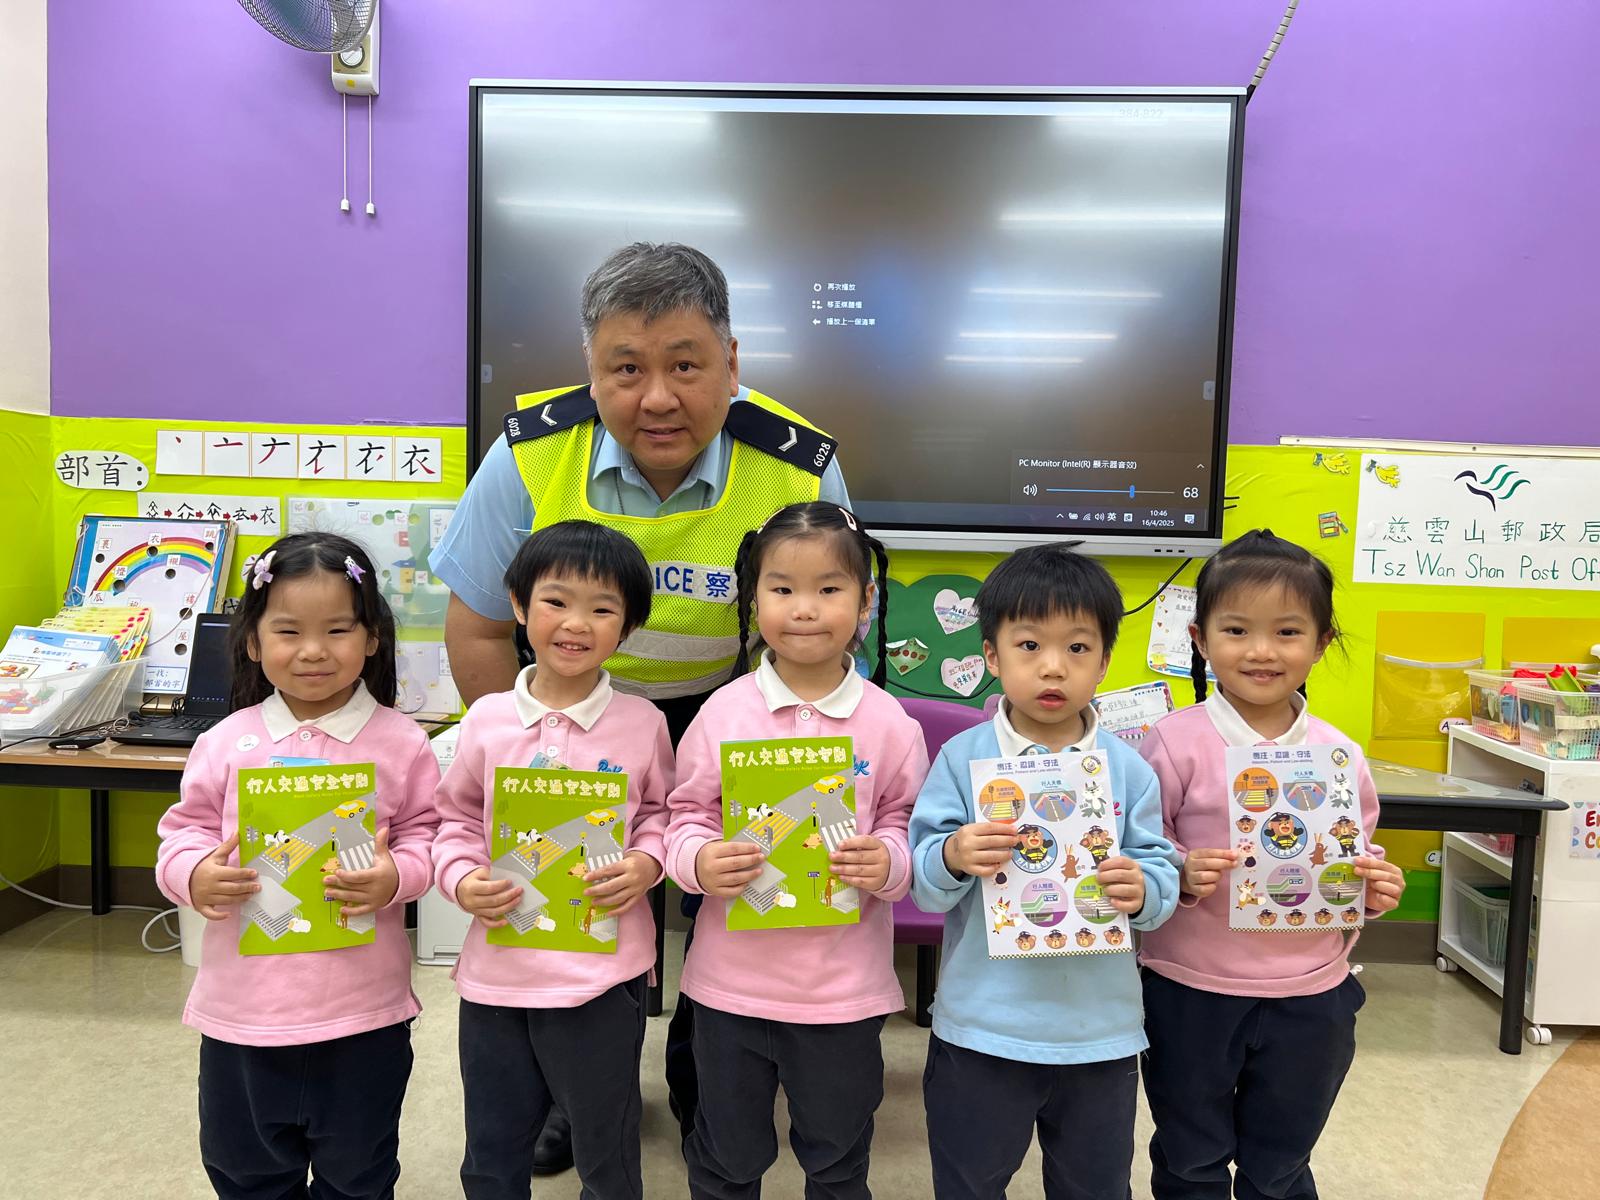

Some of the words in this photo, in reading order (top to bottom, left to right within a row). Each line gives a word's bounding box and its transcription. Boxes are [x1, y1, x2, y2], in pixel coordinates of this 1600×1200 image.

[507, 417, 521, 437] 6028
[813, 442, 831, 467] 6028
[1018, 459, 1029, 467] PC
[1030, 459, 1060, 468] Monitor
[1062, 459, 1091, 469] (Intel(R)
[1183, 487, 1199, 498] 68
[1107, 512, 1117, 522] 英
[1141, 518, 1175, 527] 16/4/2025
[1383, 515, 1600, 545] 慈雲山郵政局
[1362, 548, 1406, 577] Tsz
[1416, 550, 1456, 577] Wan
[1520, 554, 1559, 580] Post
[1571, 557, 1600, 581] Of
[655, 566, 694, 594] ICE
[705, 571, 731, 598] 察
[729, 746, 847, 768] 行人交通安全守則
[246, 772, 369, 795] 行人交通安全守則
[502, 776, 621, 799] 行人交通安全守則
